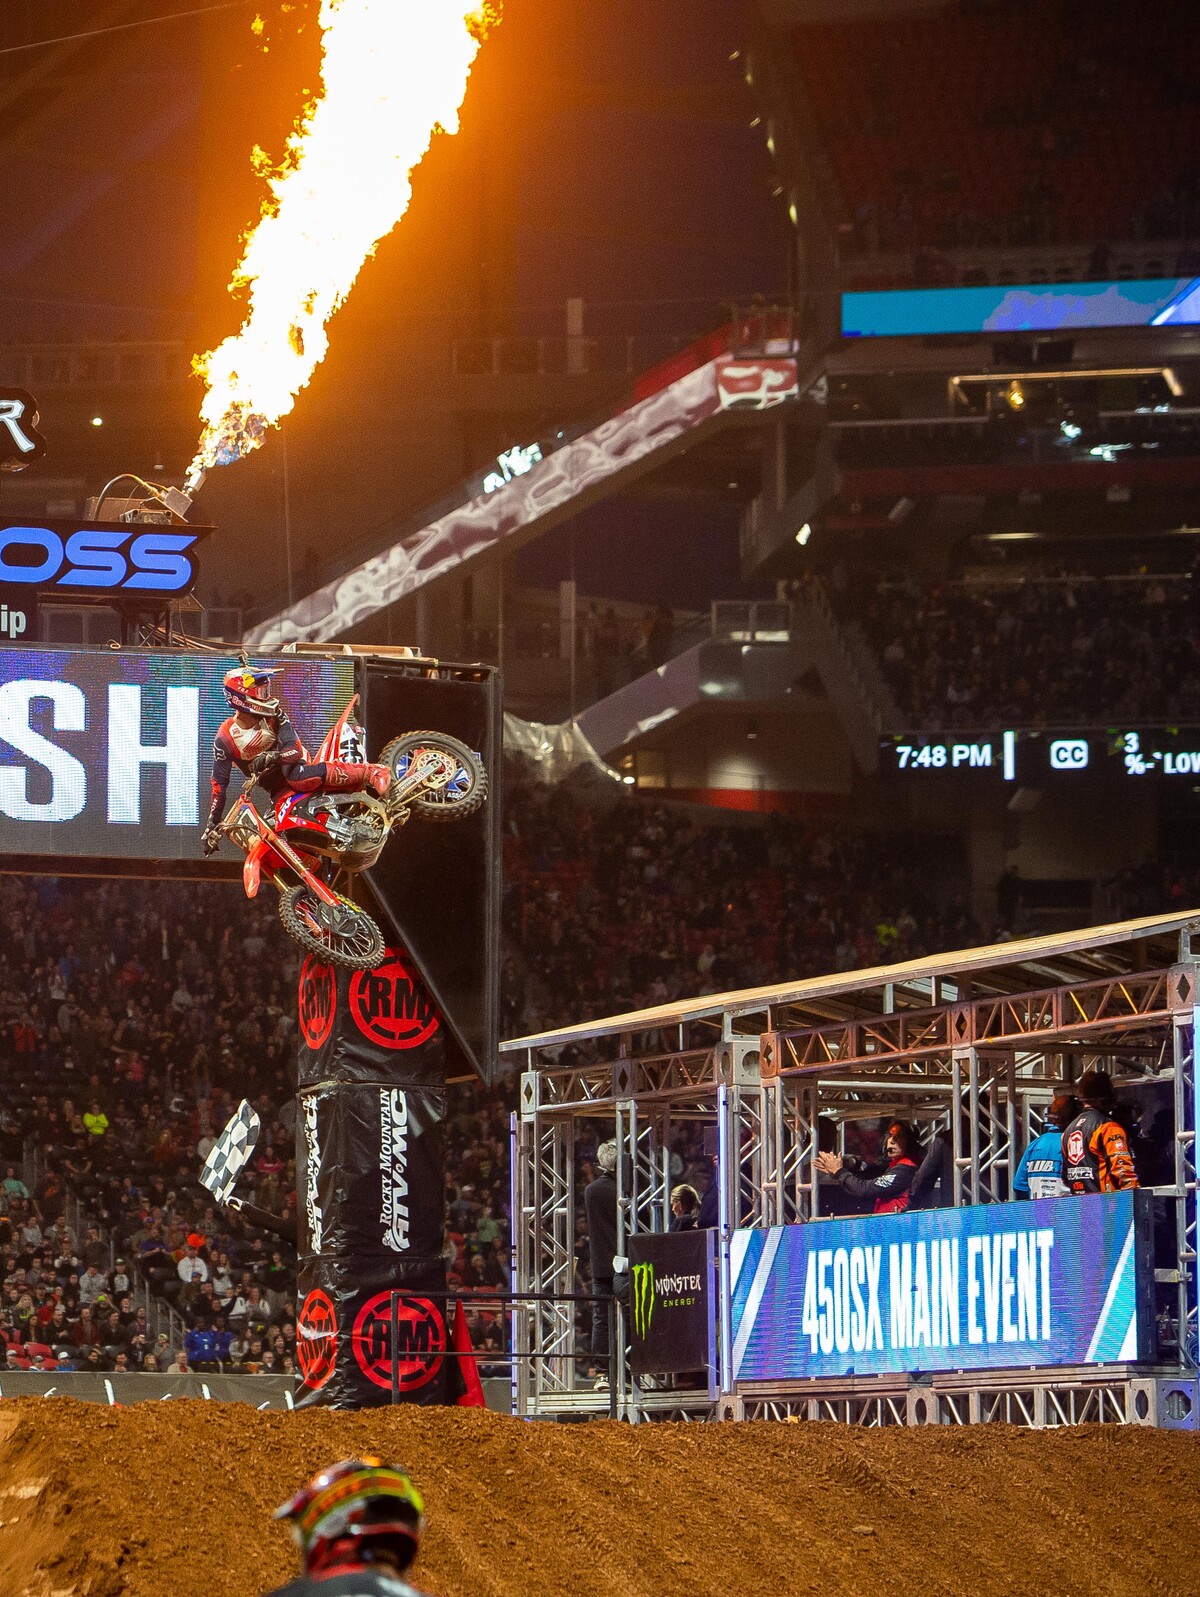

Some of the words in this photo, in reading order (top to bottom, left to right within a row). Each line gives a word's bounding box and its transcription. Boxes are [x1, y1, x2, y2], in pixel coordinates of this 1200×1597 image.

[896, 744, 947, 768] 7:48
[952, 744, 992, 767] PM
[379, 1087, 392, 1175] MOUNTAIN
[379, 1175, 392, 1226] ROCKY
[655, 1274, 702, 1296] MONSTER
[663, 1297, 696, 1308] ENERGY
[802, 1245, 884, 1354] 450SX
[889, 1238, 960, 1349] MAIN
[967, 1228, 1054, 1344] EVENT
